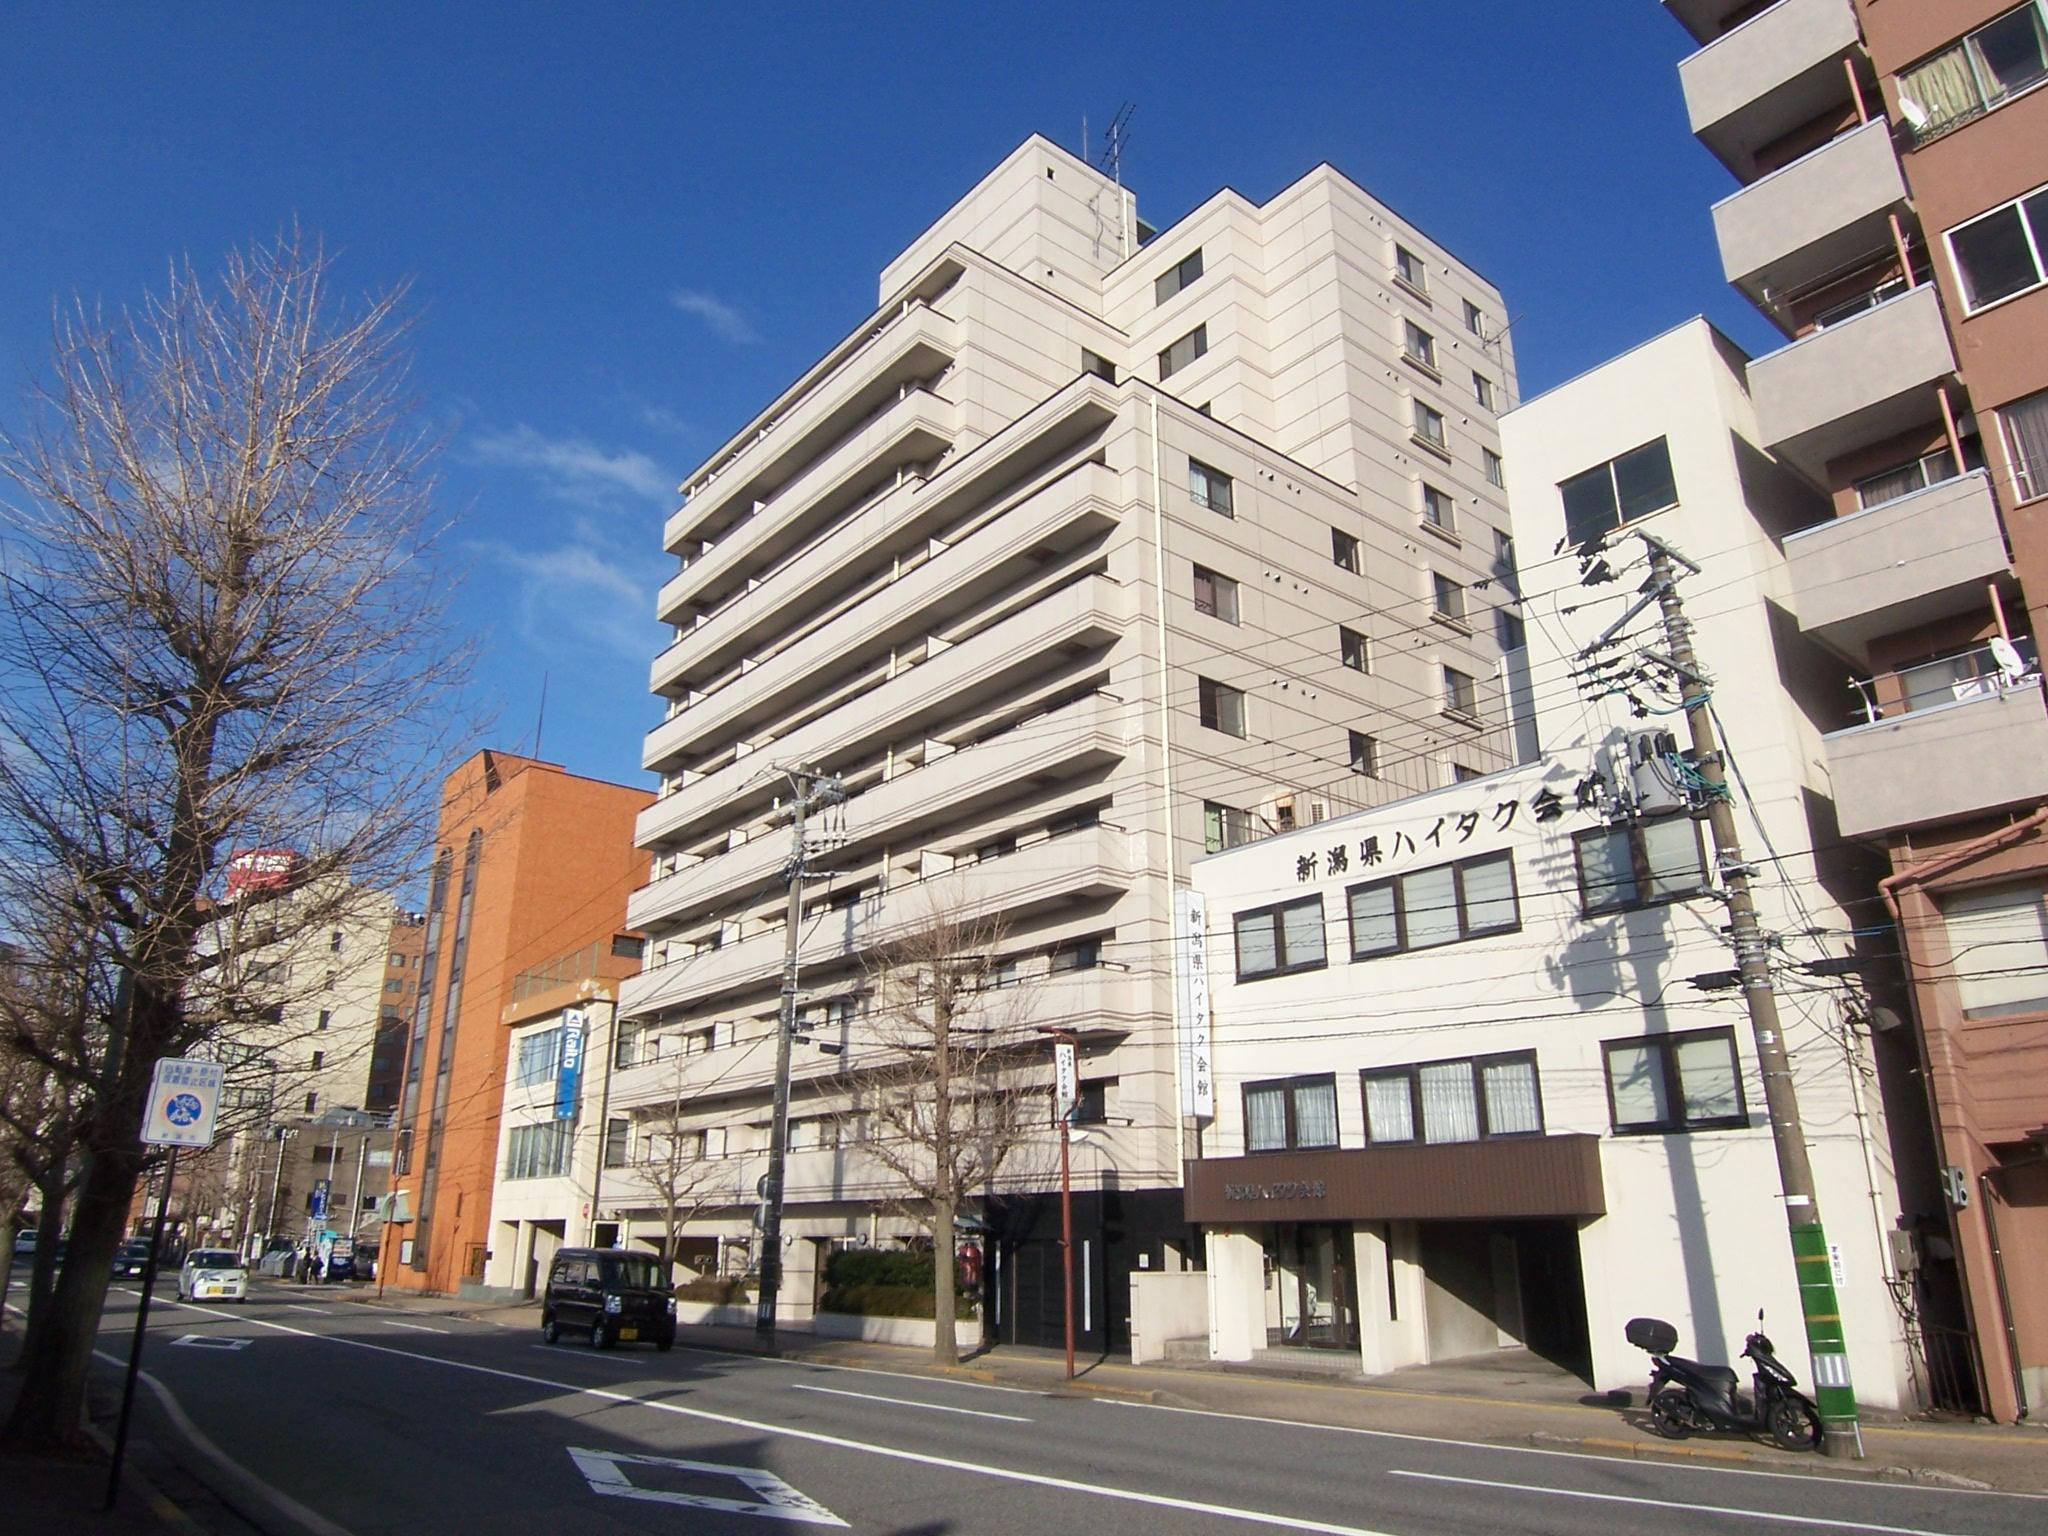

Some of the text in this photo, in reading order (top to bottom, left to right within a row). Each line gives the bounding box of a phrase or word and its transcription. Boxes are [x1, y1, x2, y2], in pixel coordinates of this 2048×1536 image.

[1190, 908, 1209, 1097] 新潟県ハイタク会館
